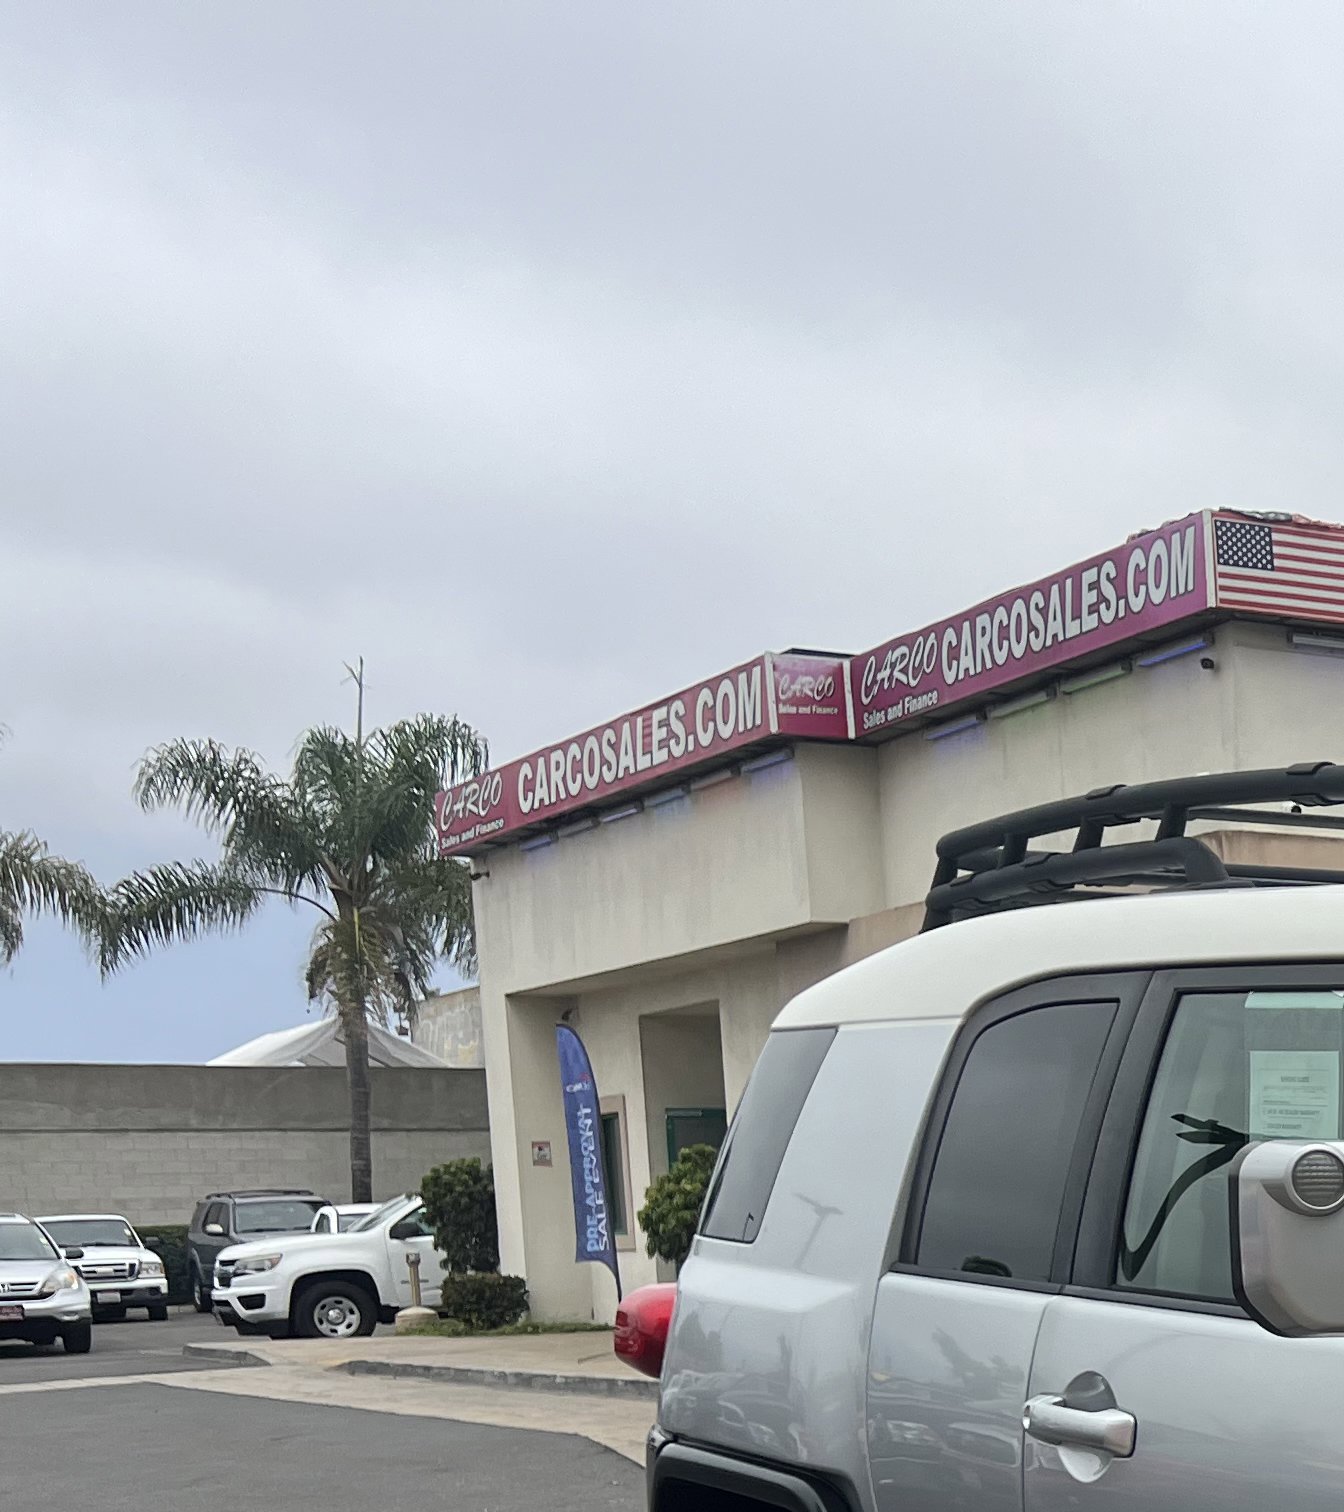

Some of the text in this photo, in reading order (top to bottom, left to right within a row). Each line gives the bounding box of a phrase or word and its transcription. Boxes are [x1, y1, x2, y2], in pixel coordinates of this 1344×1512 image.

[861, 525, 1195, 705] CARCO CARCOSALES.COM
[779, 674, 834, 701] CARCO
[863, 690, 938, 729] Sales and Finance
[441, 665, 762, 831] CARCO CARCOSALES.COM
